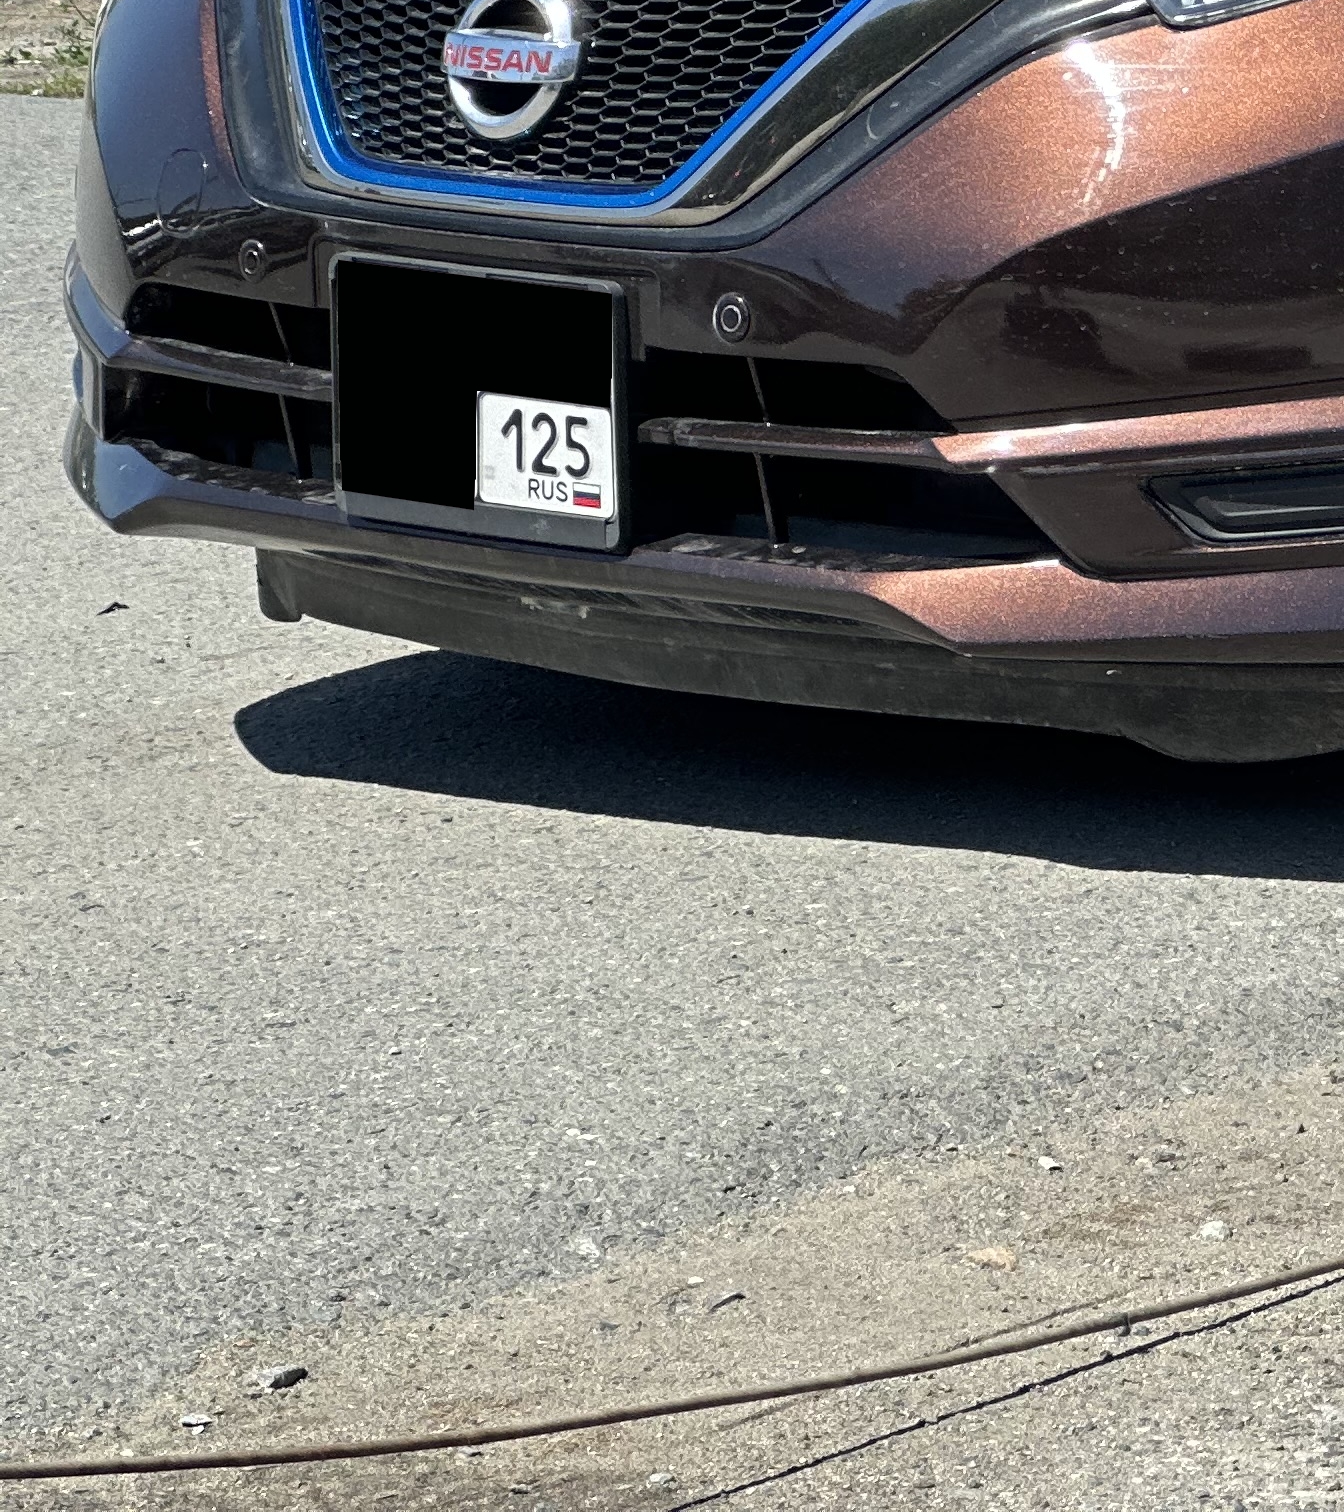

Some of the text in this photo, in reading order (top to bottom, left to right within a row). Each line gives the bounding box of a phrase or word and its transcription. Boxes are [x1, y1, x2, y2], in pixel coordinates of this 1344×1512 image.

[443, 41, 553, 75] NISSAN
[501, 407, 591, 478] 125
[527, 479, 568, 502] RUS
